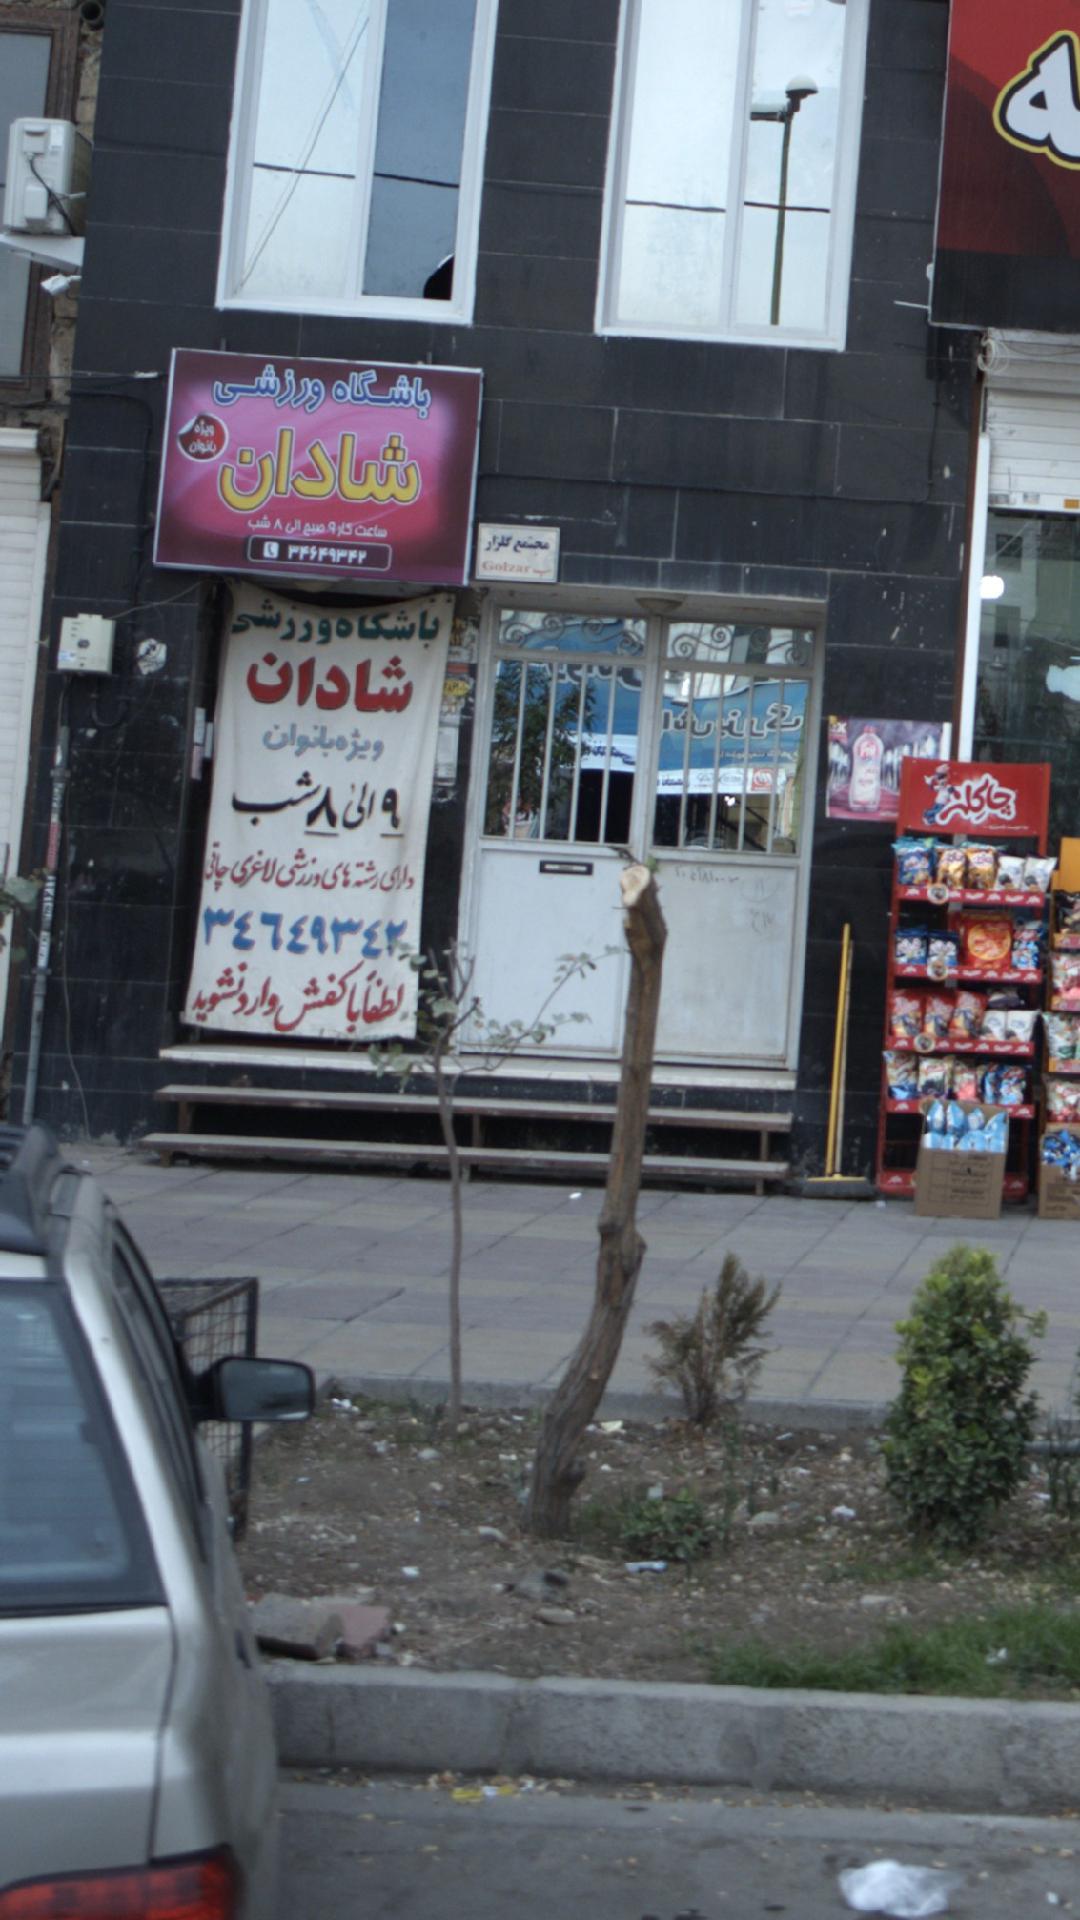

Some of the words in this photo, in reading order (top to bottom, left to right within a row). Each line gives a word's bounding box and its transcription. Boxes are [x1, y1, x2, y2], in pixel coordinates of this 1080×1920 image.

[213, 364, 325, 412] ورزشی
[332, 370, 431, 419] باشگاه
[218, 427, 422, 512] شادان
[247, 514, 271, 531] شب
[285, 519, 301, 534] الی
[303, 522, 325, 536] صبح
[337, 522, 353, 537] کار
[354, 524, 388, 538] ساعت
[513, 536, 550, 556] مجتمع
[482, 561, 530, 574] Golzar
[231, 599, 332, 645] ورزشی
[247, 652, 413, 713] شادان
[262, 723, 336, 757] بانوان
[335, 728, 385, 762] ویژه
[231, 770, 321, 827] شب
[230, 850, 277, 888] لاغری
[275, 848, 321, 888] ورزشی
[321, 861, 351, 890] های
[352, 859, 380, 889] رشته
[380, 864, 415, 892] دارای
[192, 962, 248, 1022] نشوید
[233, 976, 279, 1016] وارد
[274, 960, 365, 1032] کفش
[346, 982, 359, 1033] با
